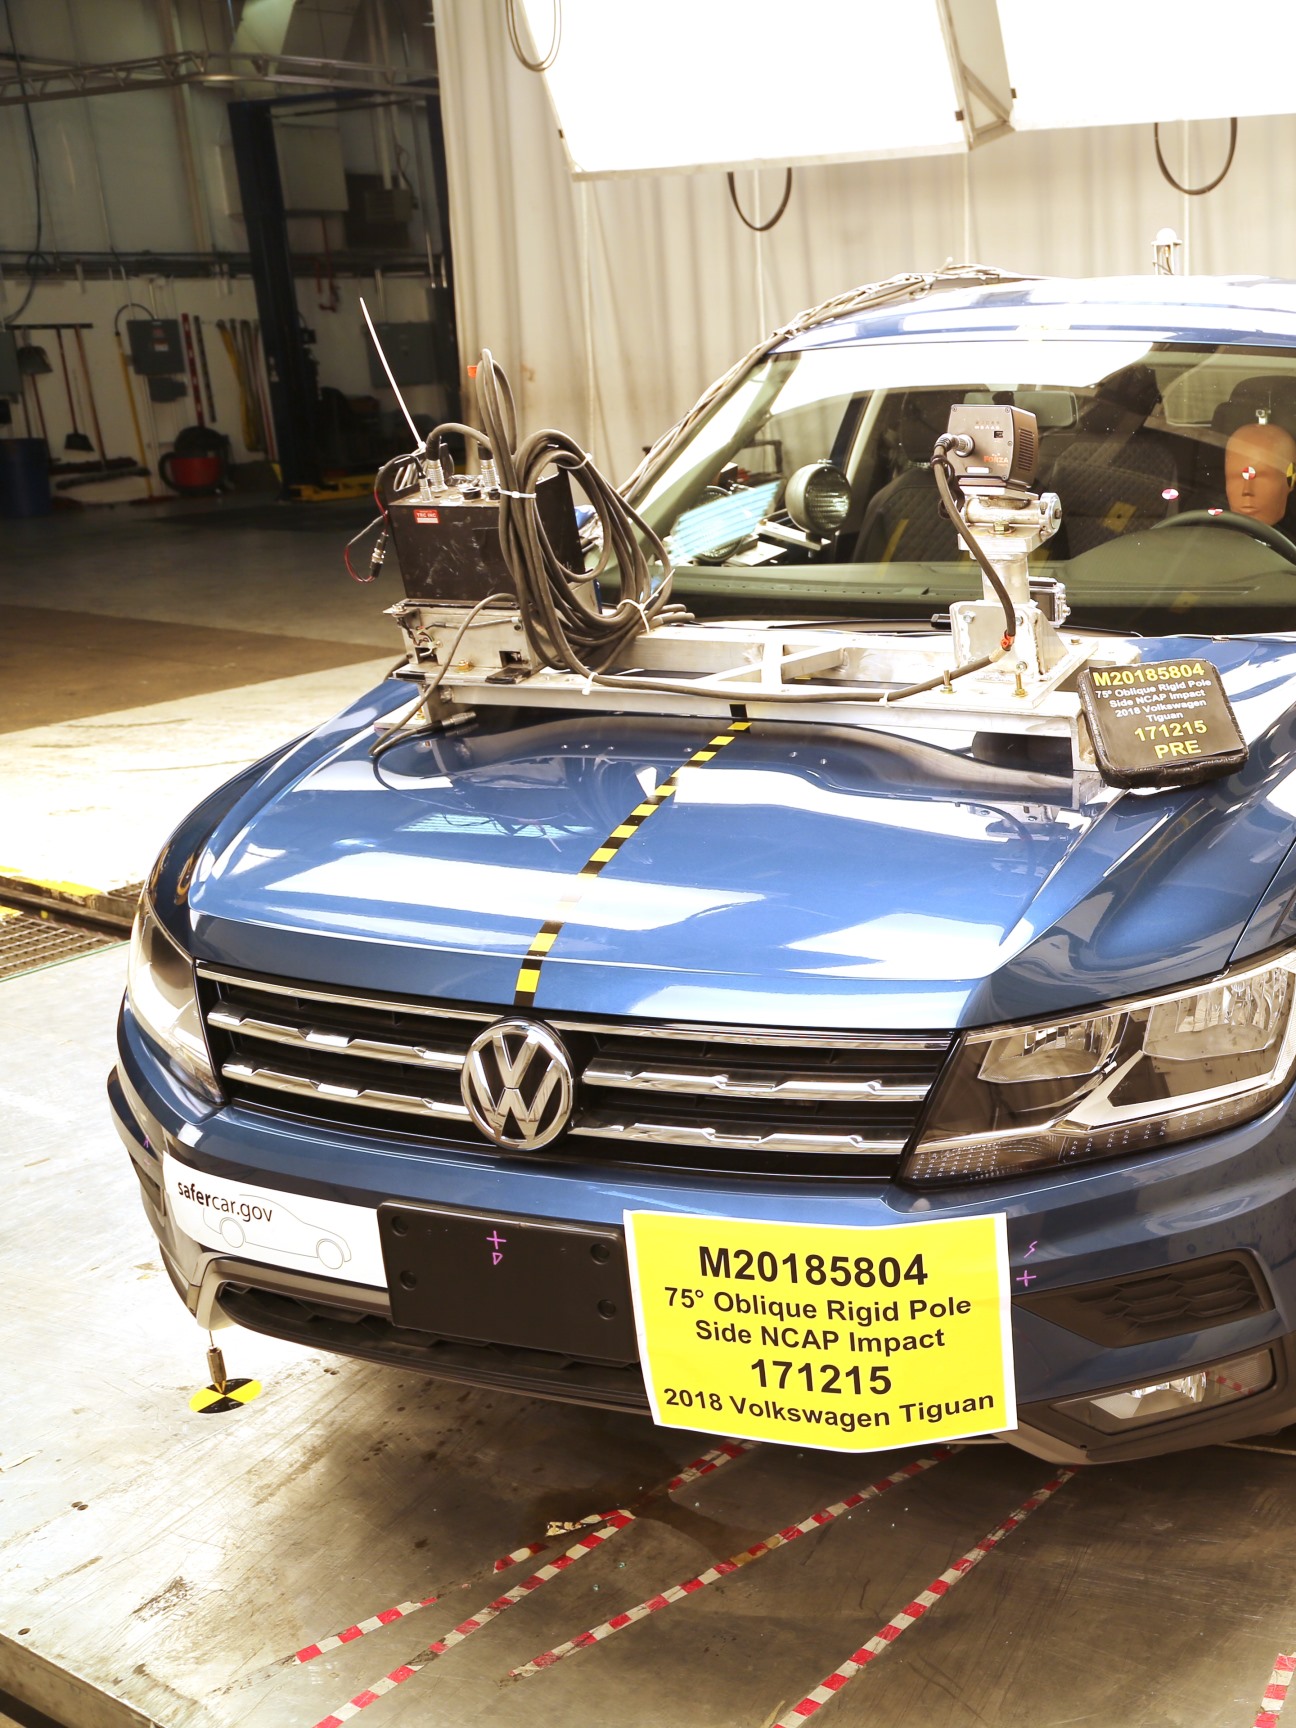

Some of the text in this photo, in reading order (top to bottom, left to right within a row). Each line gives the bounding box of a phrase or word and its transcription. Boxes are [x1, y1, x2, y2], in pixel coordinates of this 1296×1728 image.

[1093, 662, 1205, 687] M20185804
[1109, 689, 1206, 708] Side NCAP Impact
[1115, 686, 1156, 698] Oblique
[1159, 682, 1187, 694] Rigid
[1189, 679, 1212, 689] Pole
[1115, 698, 1207, 718] 2018 Volkswagen
[1146, 711, 1184, 723] Tiguan
[1134, 719, 1208, 742] 171215
[1154, 740, 1202, 759] PRE
[177, 1179, 274, 1223] safercar.gov
[699, 1245, 929, 1288] M20185804
[664, 1286, 972, 1327] 75° Oblique Rigid Pole
[695, 1319, 945, 1357] Side NCAP Impact
[751, 1358, 892, 1395] 171215
[663, 1388, 995, 1433] 2018 Volkswagen Tiguan
